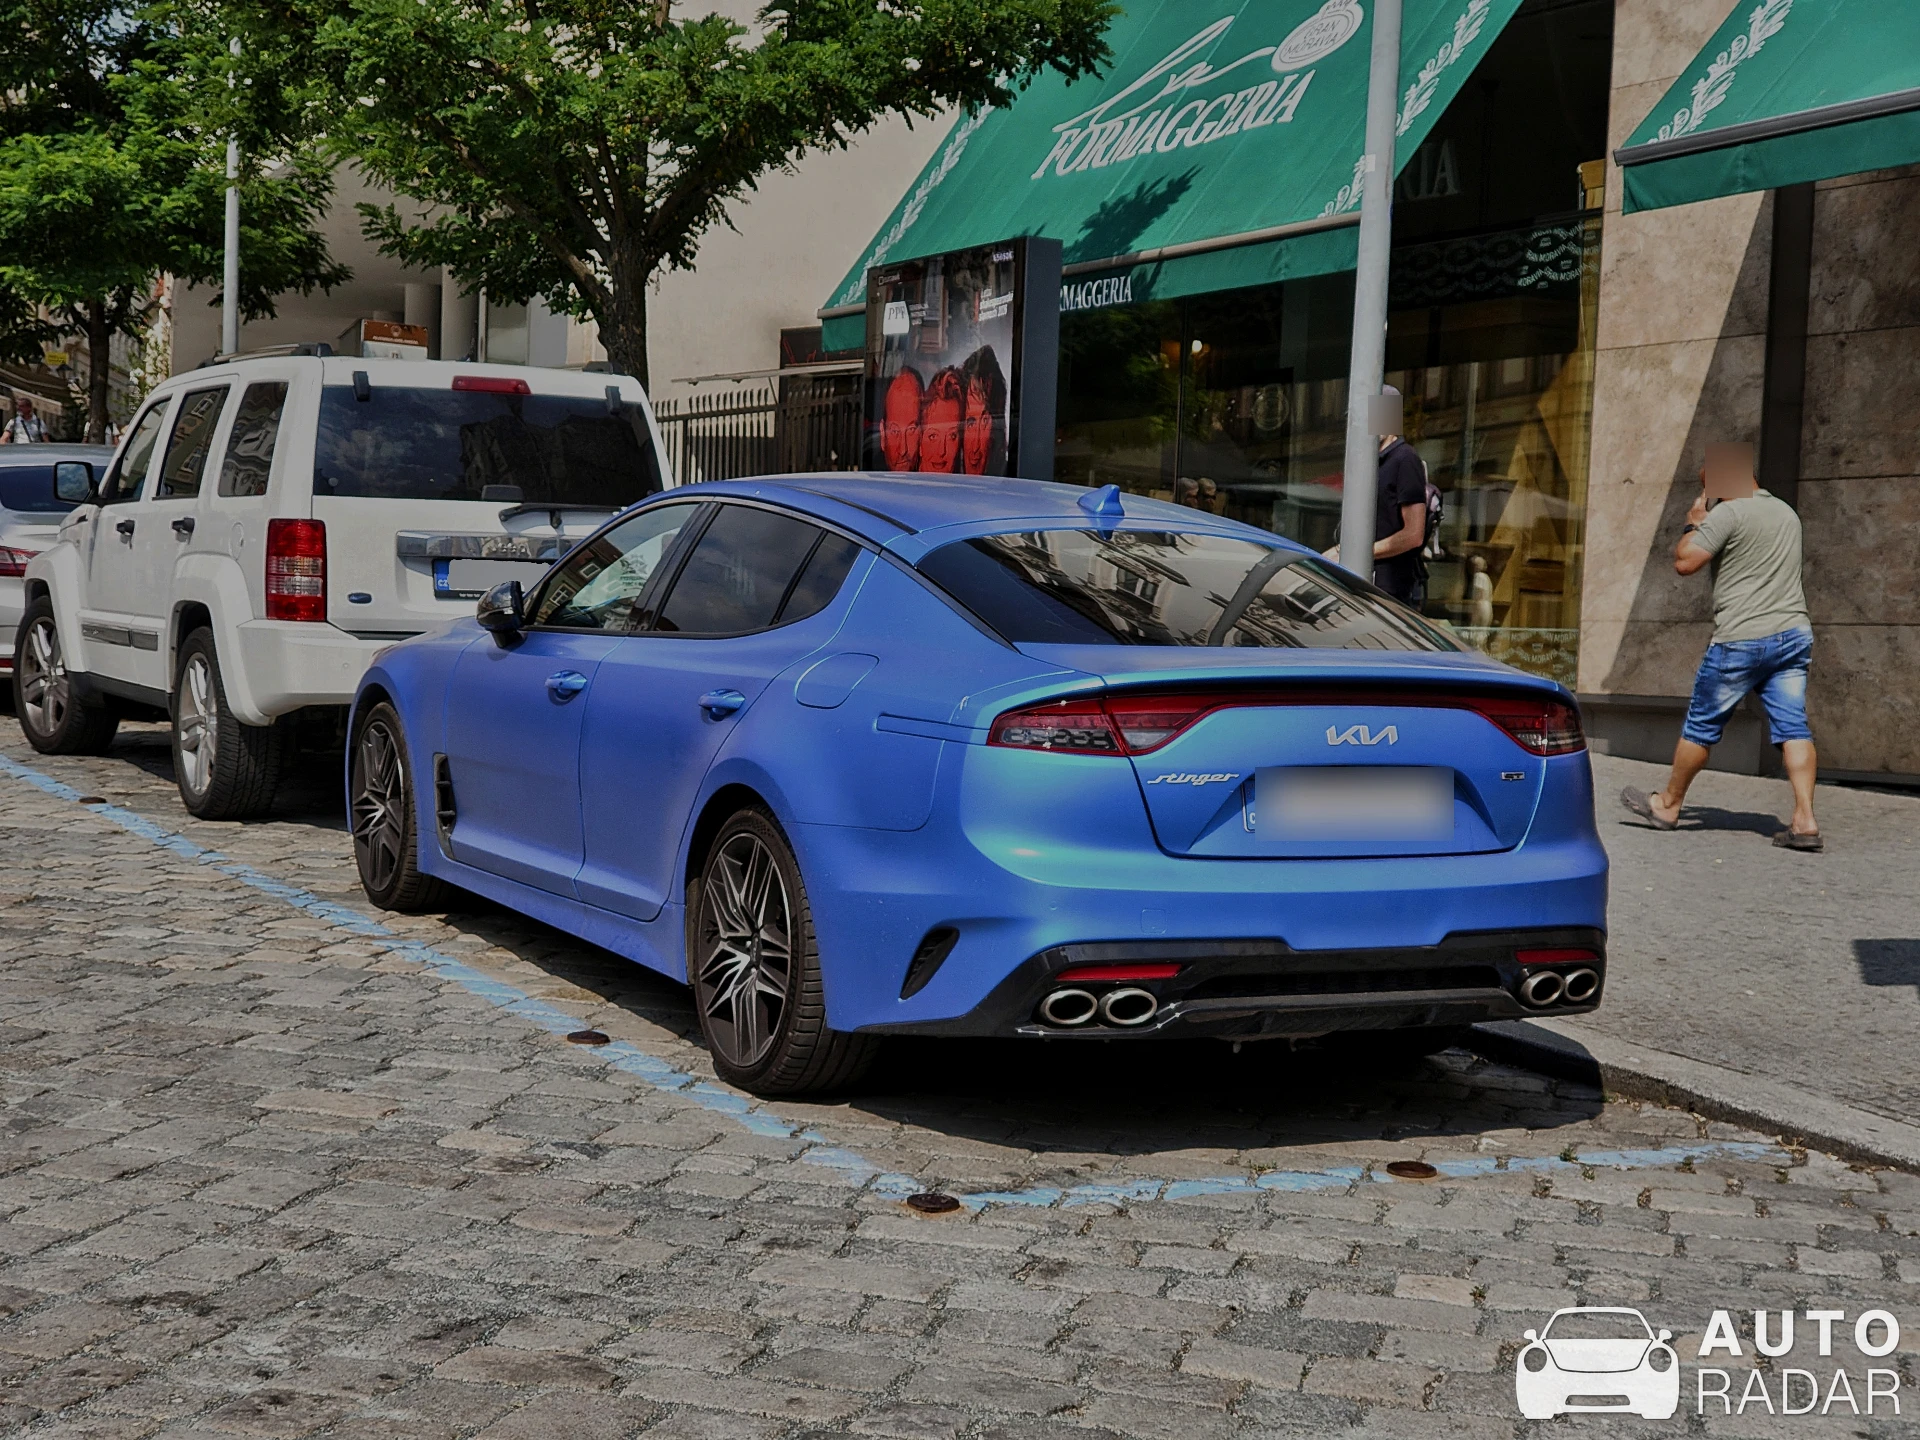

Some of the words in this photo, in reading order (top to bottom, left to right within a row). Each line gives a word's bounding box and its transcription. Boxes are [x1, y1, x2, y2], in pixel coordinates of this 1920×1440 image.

[1303, 19, 1341, 40] GRAN
[1283, 32, 1339, 58] MORAVIA
[1030, 69, 1316, 180] FORMAGGERIA
[438, 579, 448, 587] CZ
[1326, 725, 1398, 745] KIA
